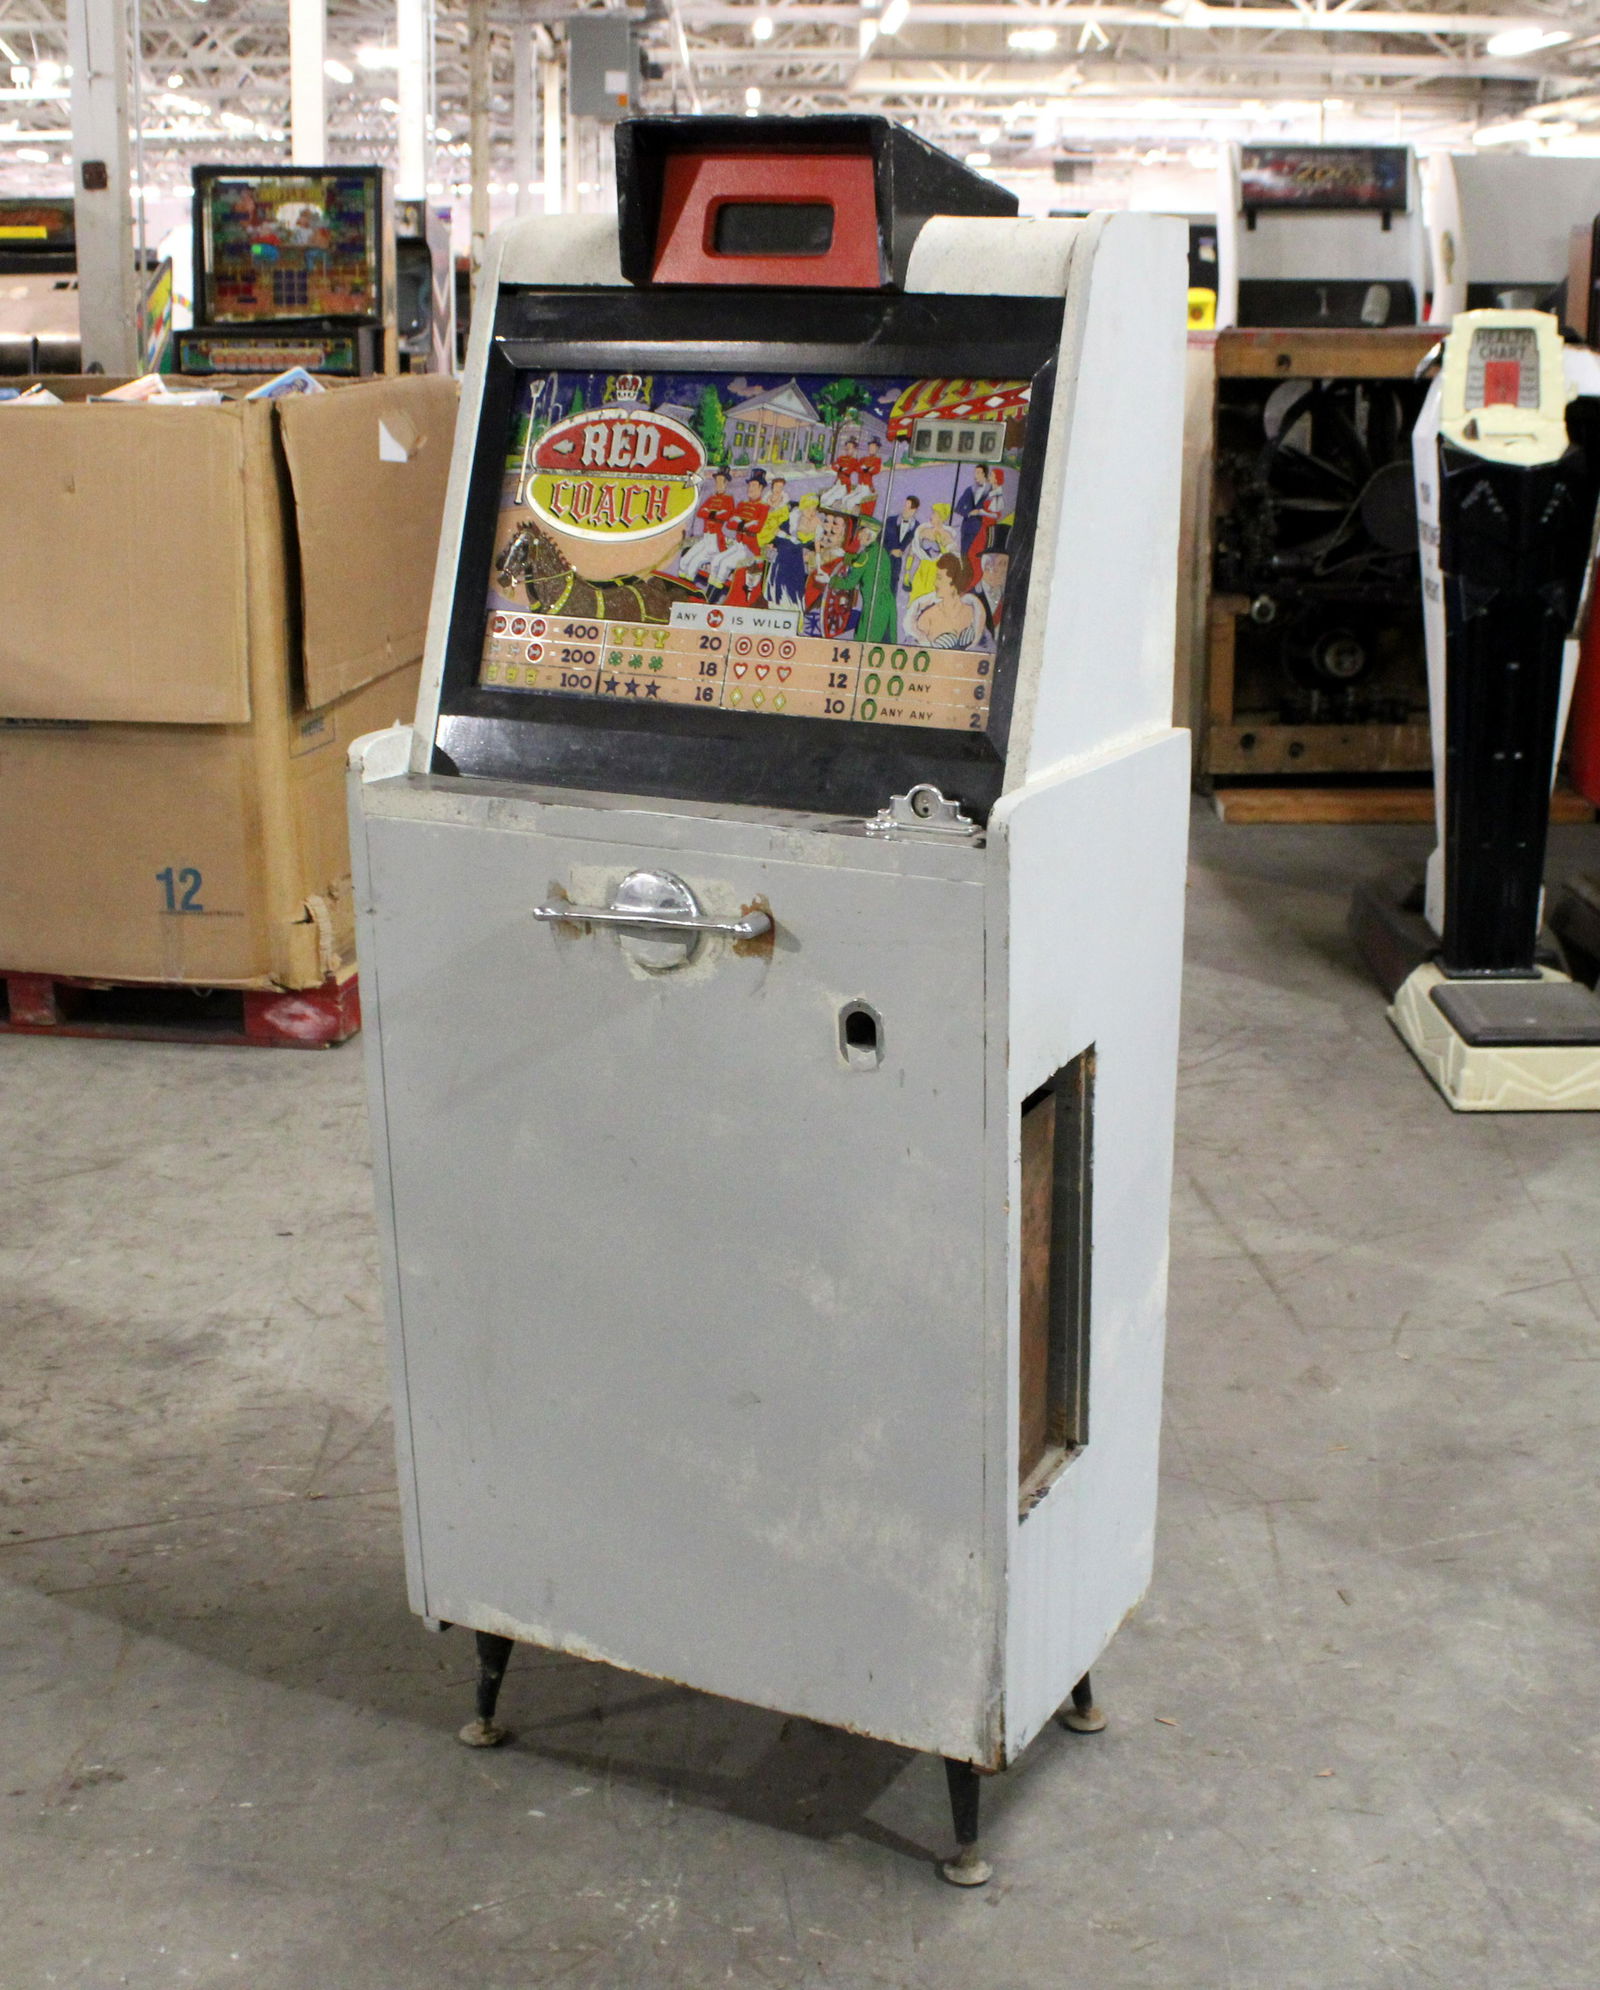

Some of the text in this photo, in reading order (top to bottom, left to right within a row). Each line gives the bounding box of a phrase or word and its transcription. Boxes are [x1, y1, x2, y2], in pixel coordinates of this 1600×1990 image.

[579, 422, 660, 469] RED
[550, 479, 671, 527] COACH
[676, 612, 792, 630] ANY IS WILD
[563, 623, 599, 640] 400
[700, 635, 722, 651] 20
[560, 649, 596, 665] 200
[831, 647, 851, 663] 14
[698, 660, 718, 676] 18
[977, 660, 989, 676] 8
[559, 672, 593, 689] 100
[828, 672, 848, 689] 12
[908, 683, 932, 694] ANY
[694, 686, 714, 703] 16
[973, 685, 985, 700] 6
[824, 698, 845, 715] 10
[880, 707, 933, 721] ANY ANY
[969, 713, 982, 729] 2
[156, 867, 203, 911] 12
